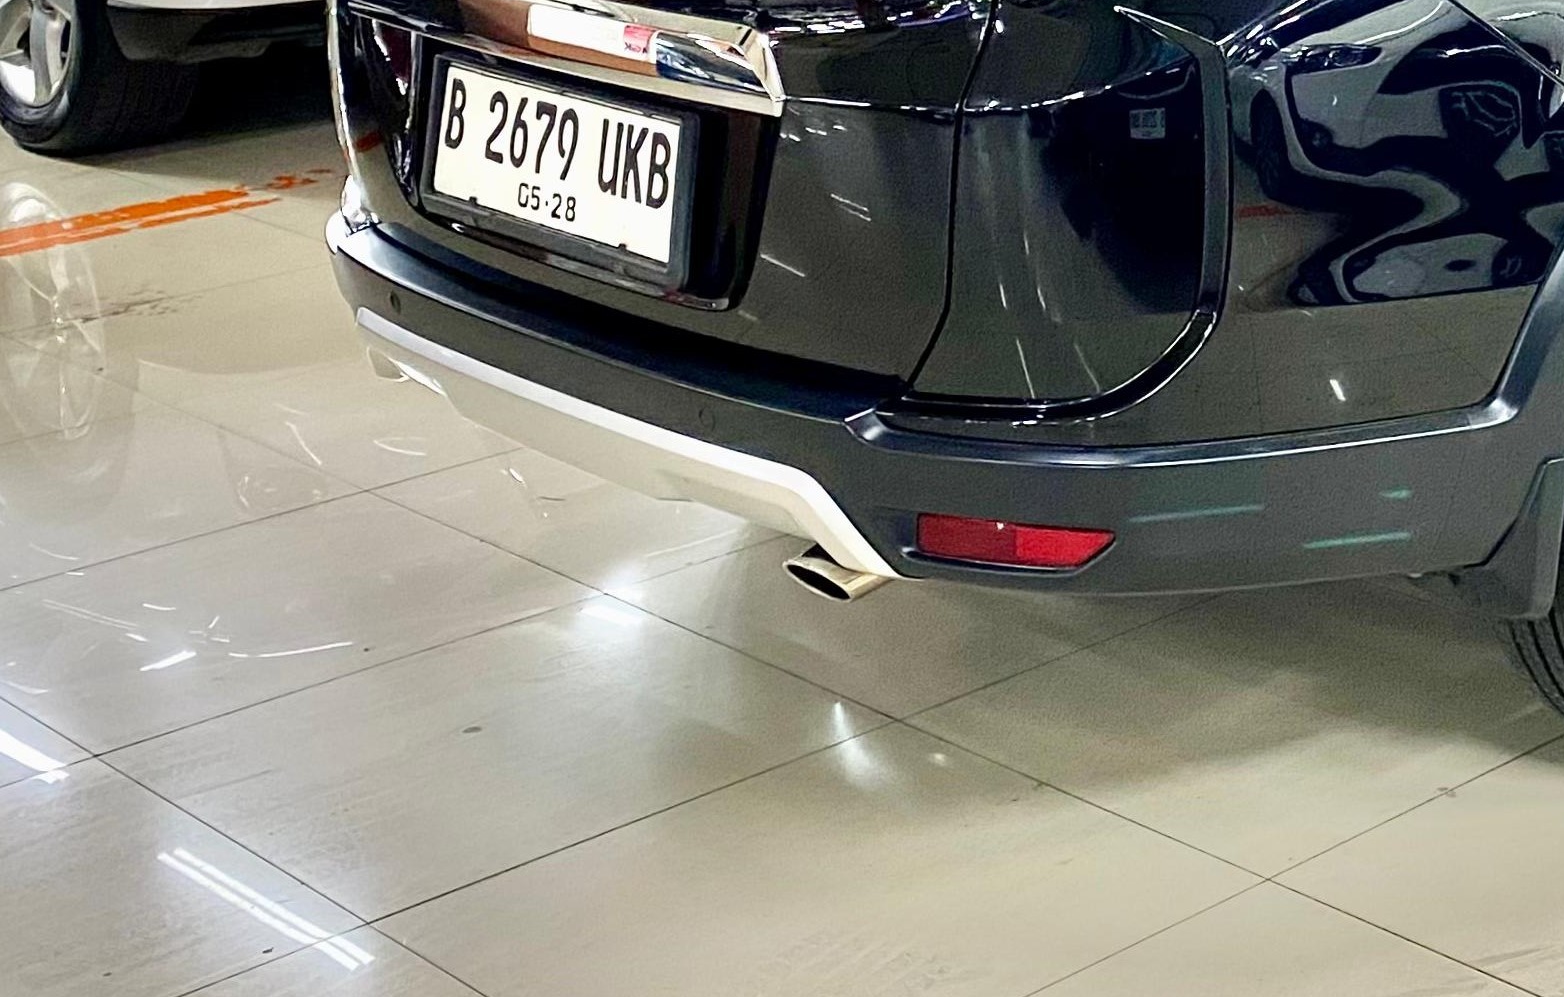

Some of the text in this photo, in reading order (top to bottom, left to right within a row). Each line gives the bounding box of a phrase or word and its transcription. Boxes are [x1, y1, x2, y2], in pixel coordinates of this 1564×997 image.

[444, 77, 672, 209] B 2679 UKB
